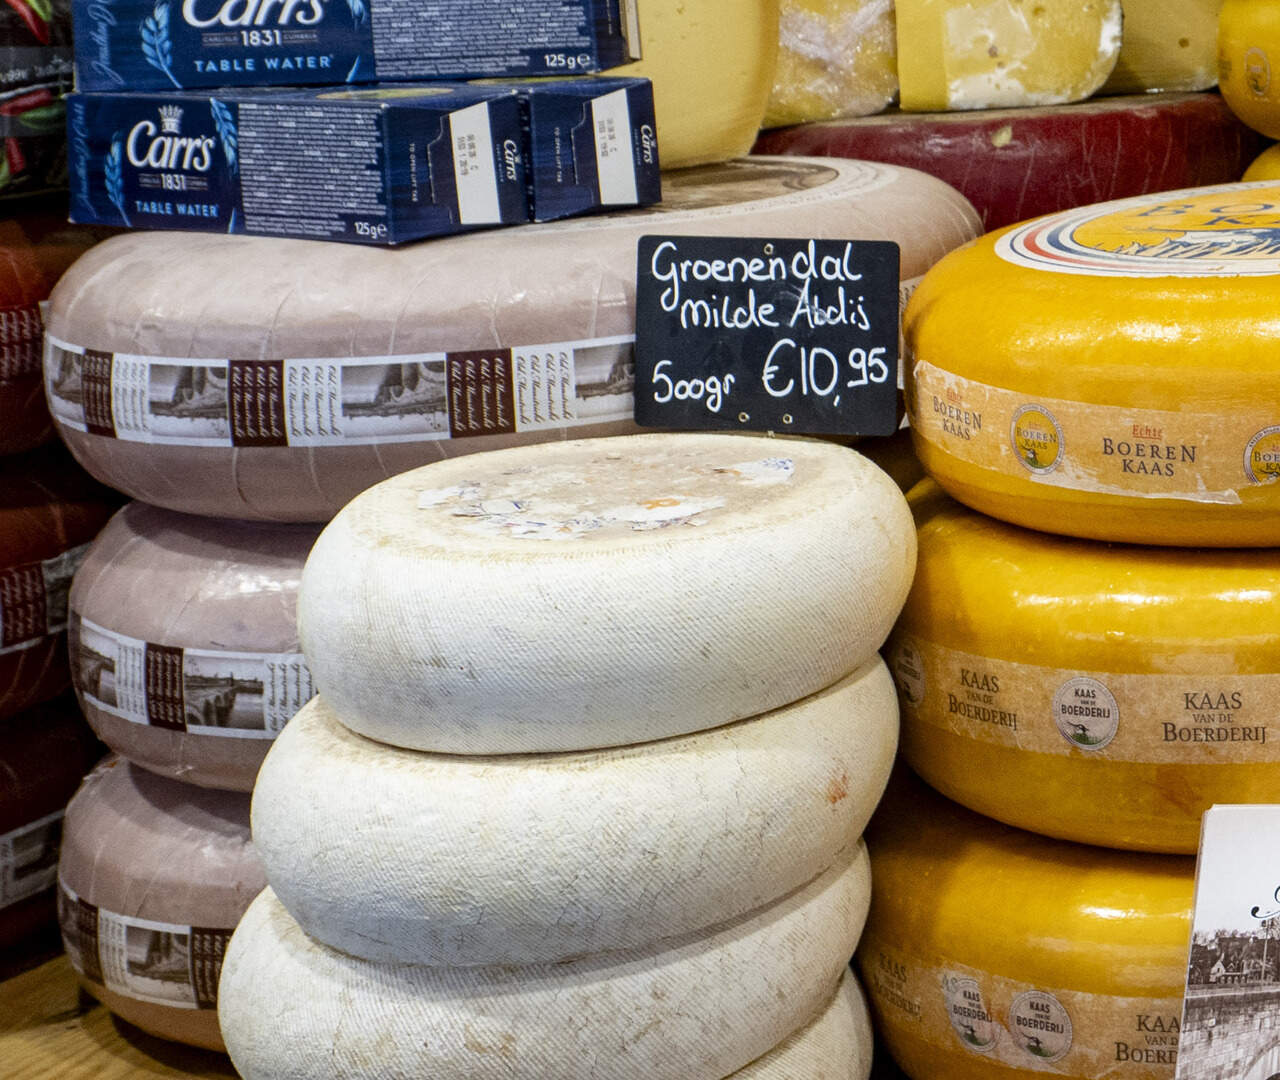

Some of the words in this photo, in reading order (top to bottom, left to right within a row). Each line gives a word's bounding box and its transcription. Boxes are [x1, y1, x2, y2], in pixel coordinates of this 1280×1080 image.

[240, 30, 283, 48] 1831
[194, 58, 255, 73] TABLE
[265, 55, 332, 70] WATER
[127, 120, 215, 172] Carr's
[160, 173, 186, 191] 1831
[136, 200, 172, 216] TABLE
[176, 203, 219, 218] WATER
[681, 288, 780, 329] milde
[652, 360, 736, 412] 500gr
[762, 338, 890, 407] €10,95
[933, 395, 983, 431] BOEREN
[942, 417, 971, 442] KAAS
[1132, 423, 1164, 440] Echte
[1103, 437, 1198, 464] BOEREN
[1122, 458, 1176, 478] KAAS
[960, 668, 1001, 694] KAAS
[1073, 687, 1097, 700] KAAS
[1184, 691, 1243, 711] KAAS
[948, 693, 1019, 732] BOERDERIJ
[1060, 704, 1112, 720] BOERDERIJ
[1193, 712, 1217, 724] VAN
[1219, 712, 1235, 724] DE
[1162, 721, 1268, 745] BOERDERIJ
[1028, 999, 1051, 1015] KAAS
[1015, 1014, 1065, 1035] BOERDERIJ
[1135, 1013, 1179, 1033] KAA
[1144, 1035, 1170, 1046] VAN
[1114, 1041, 1178, 1064] BOERD
